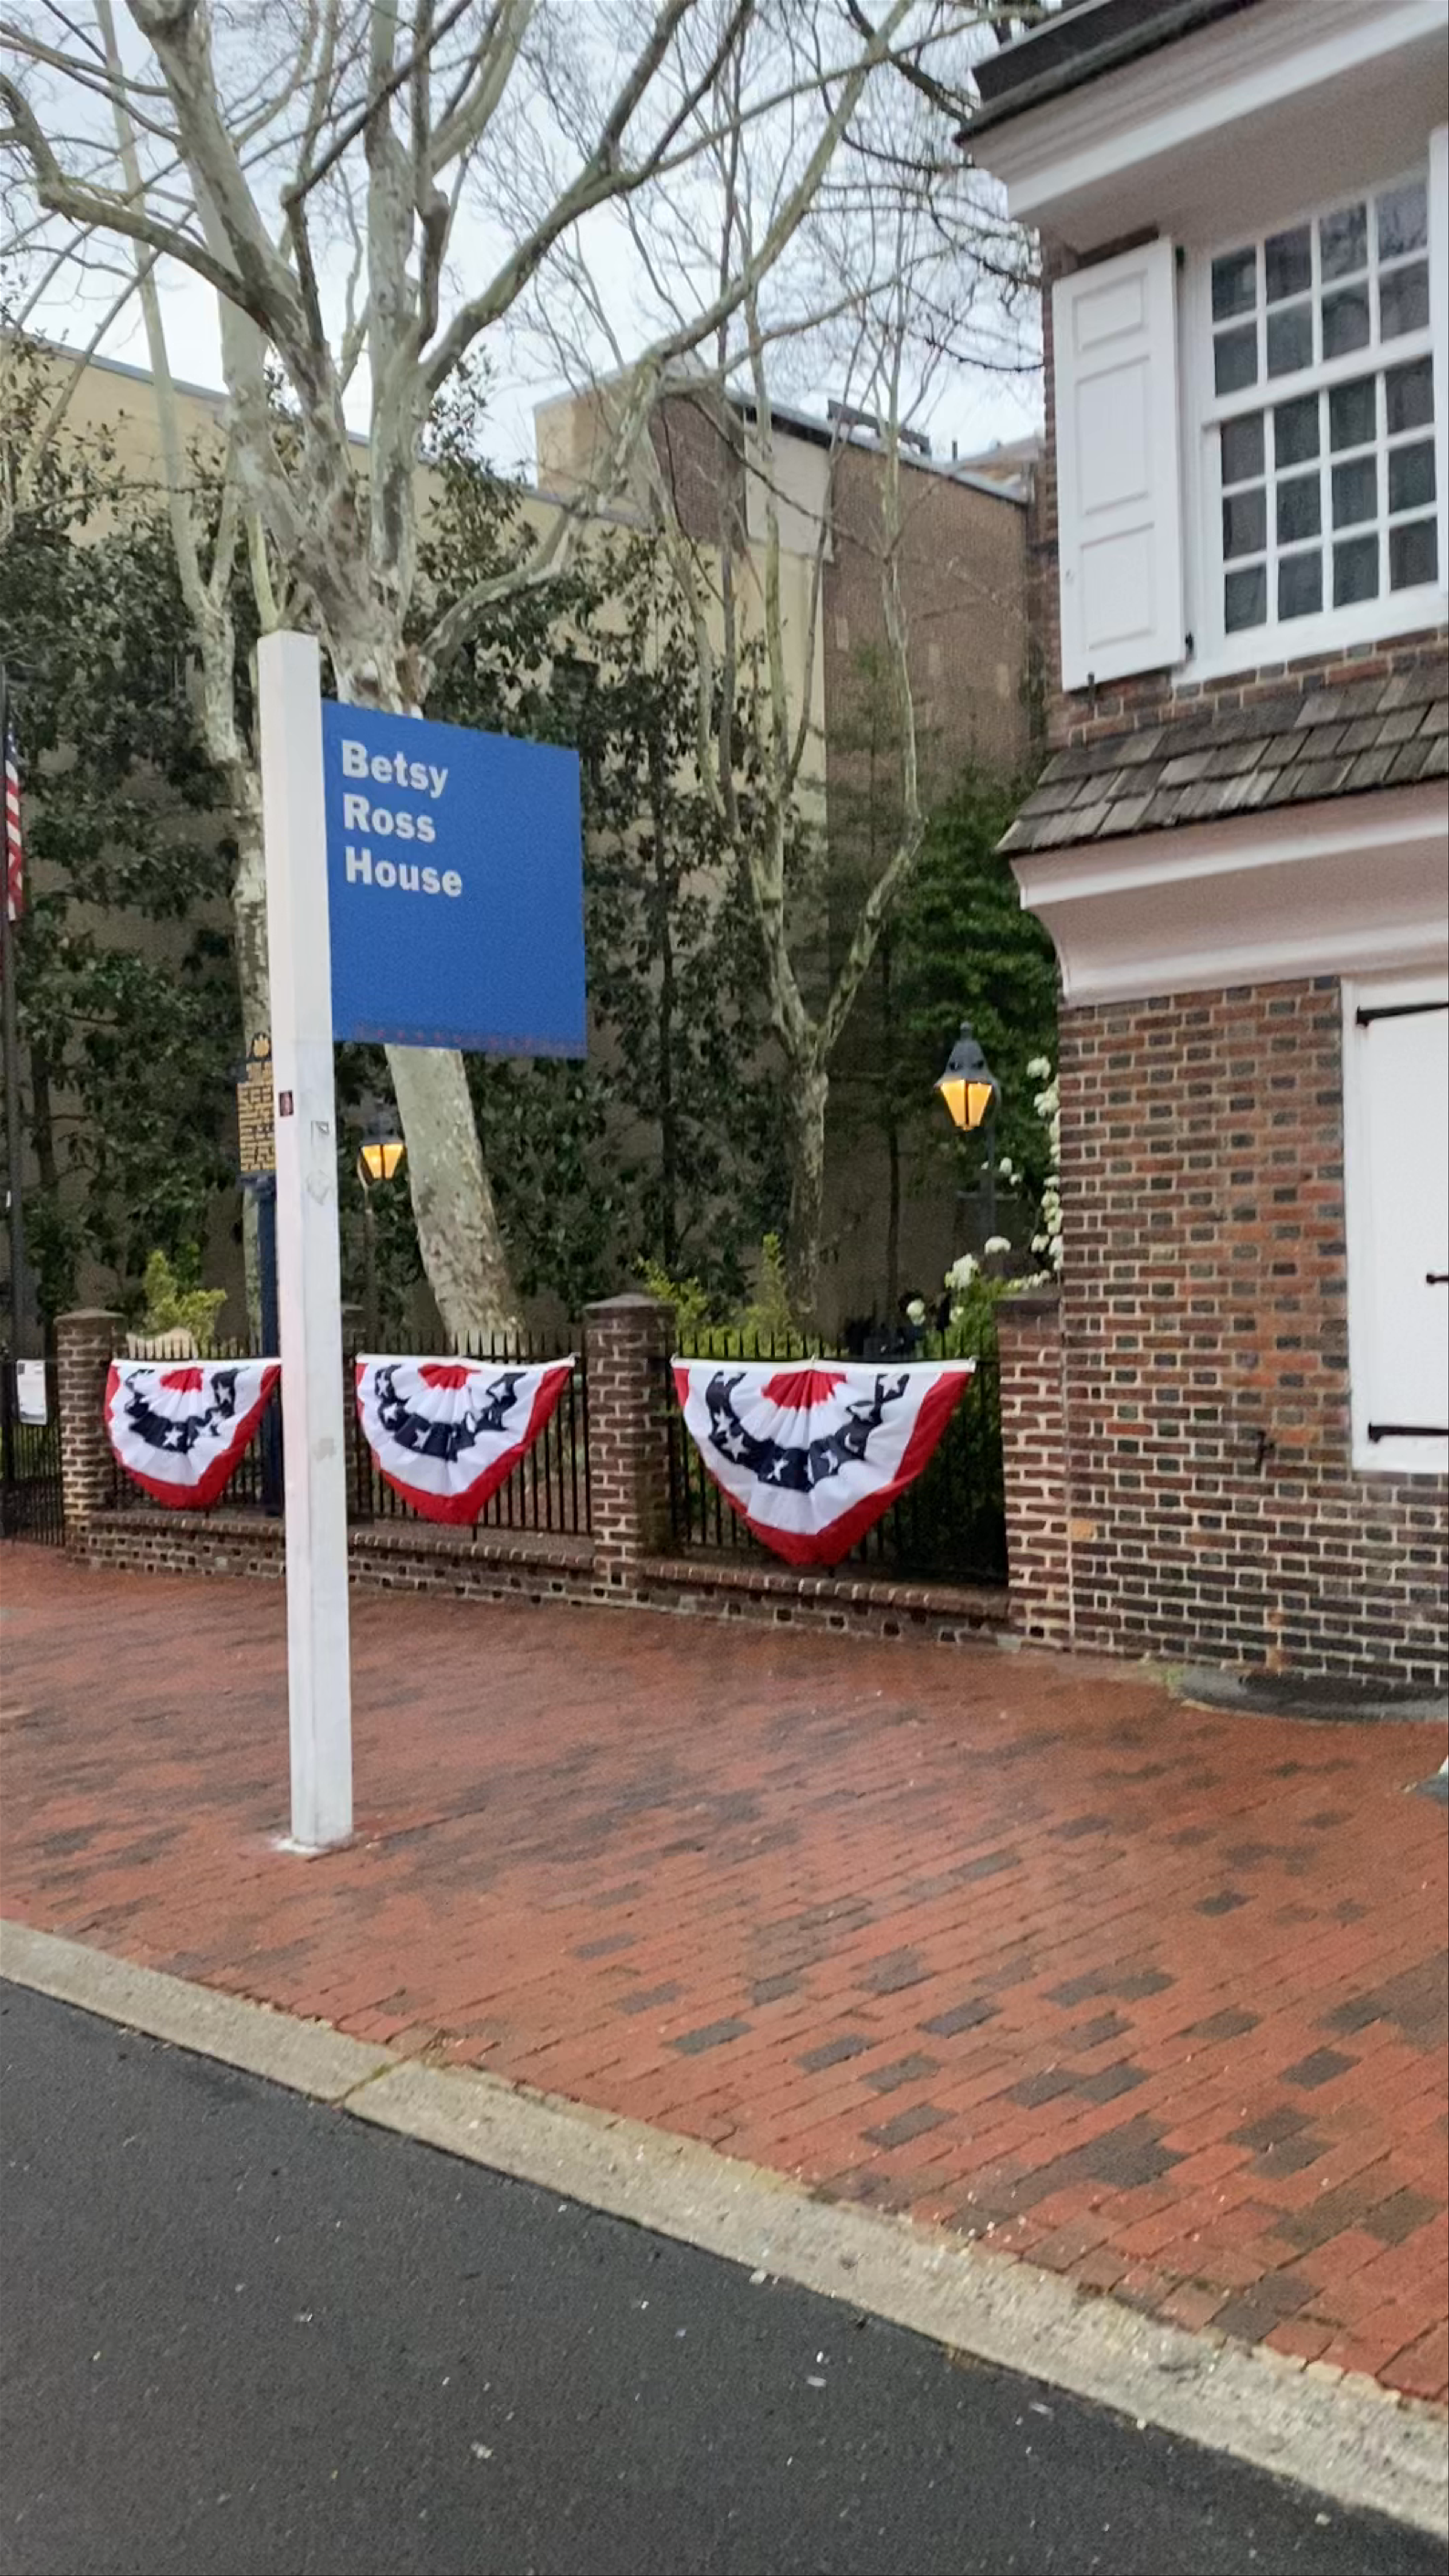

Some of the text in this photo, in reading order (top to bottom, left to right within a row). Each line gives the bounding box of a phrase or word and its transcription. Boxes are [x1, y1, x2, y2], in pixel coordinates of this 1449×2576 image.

[342, 740, 448, 798] Betsy
[343, 793, 436, 843] Ross
[346, 846, 462, 897] House
